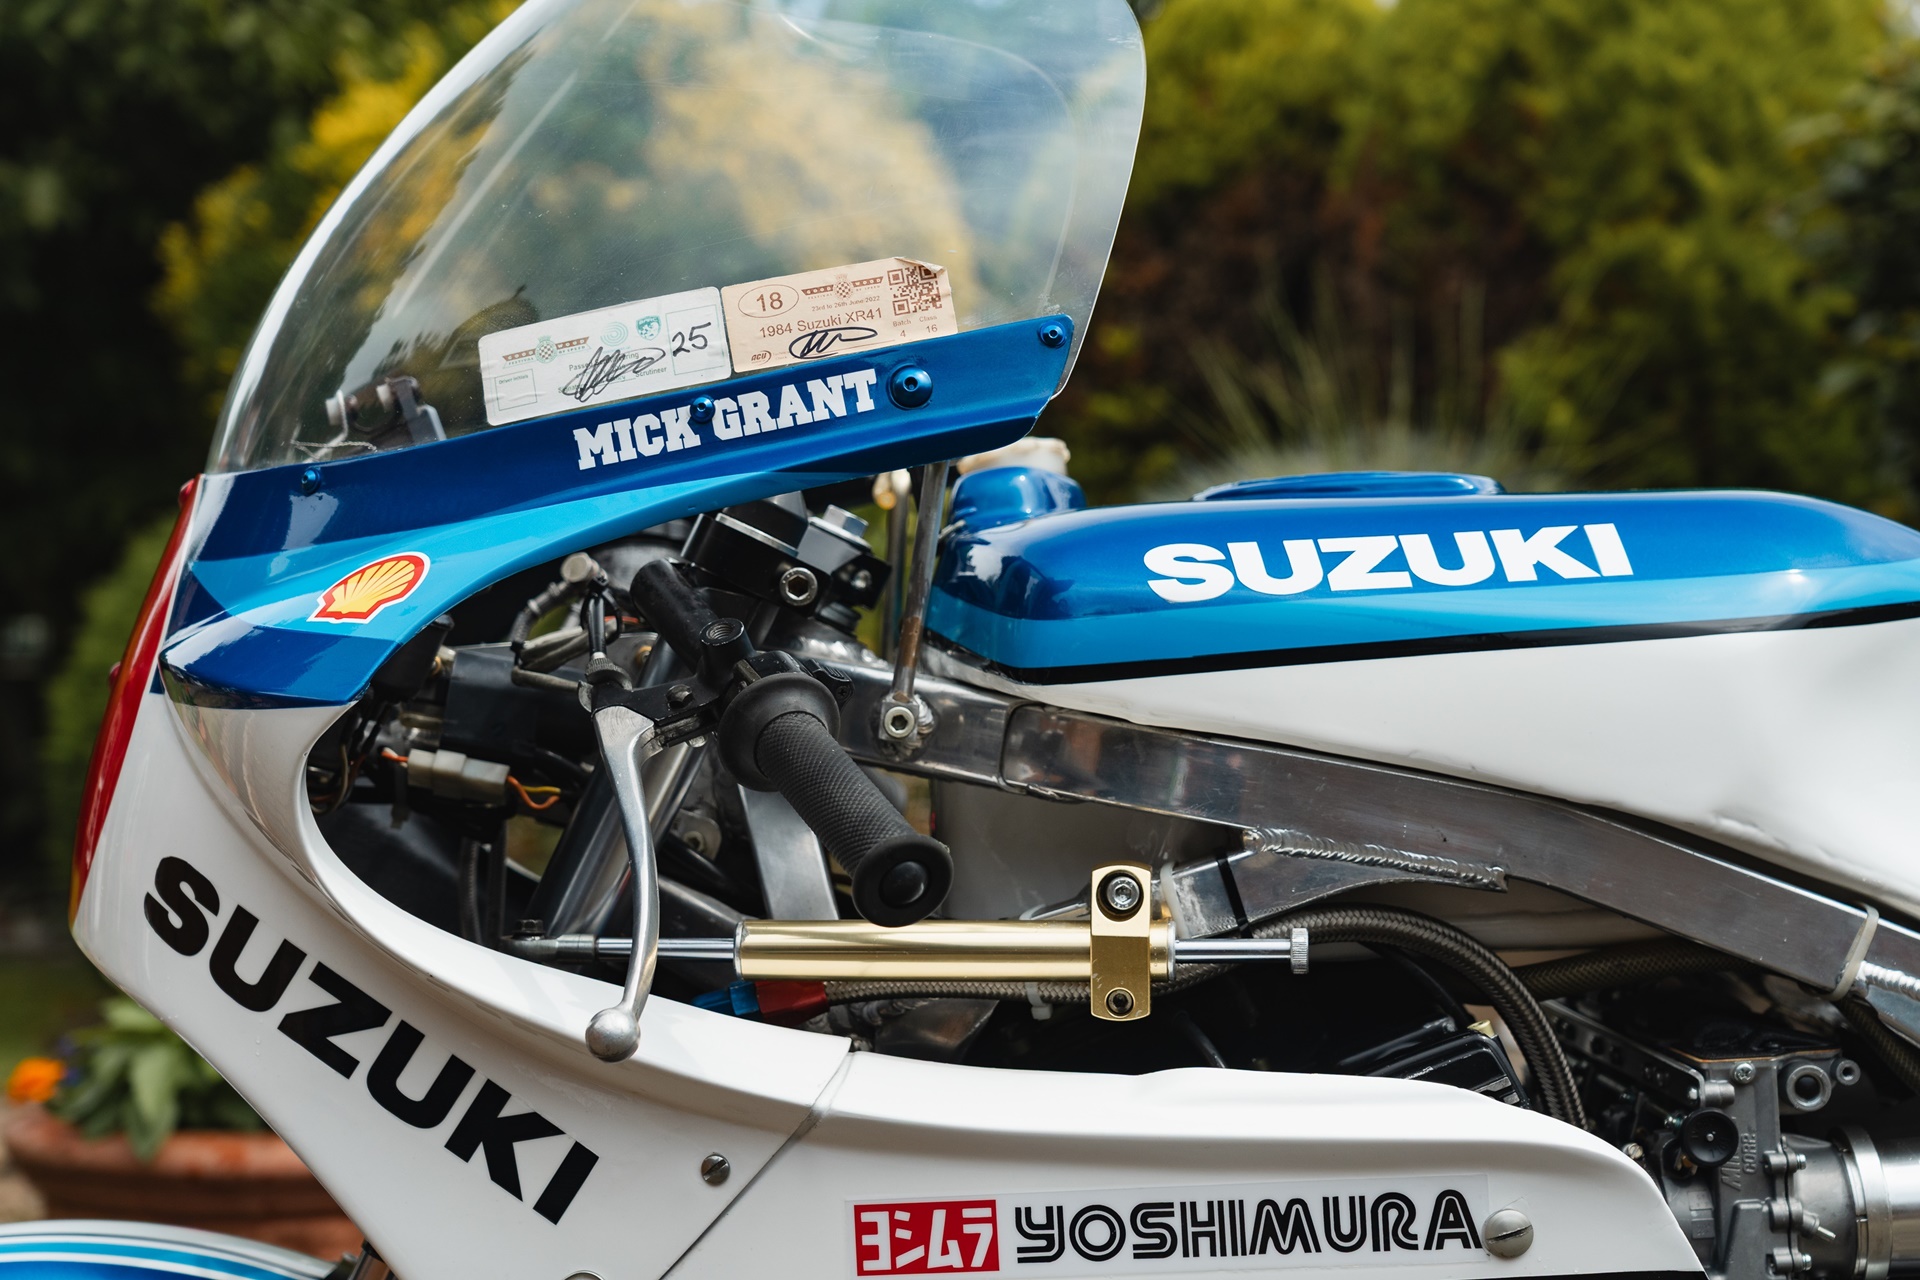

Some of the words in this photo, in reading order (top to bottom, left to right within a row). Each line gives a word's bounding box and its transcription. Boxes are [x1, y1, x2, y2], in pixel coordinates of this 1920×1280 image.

[756, 291, 784, 312] 18
[849, 298, 864, 306] June
[865, 295, 881, 303] 2022
[759, 320, 793, 338] 1984
[797, 313, 842, 332] Suzuki
[846, 307, 883, 324] XR41
[892, 319, 912, 327] Batch
[899, 329, 907, 338] 4
[918, 314, 938, 323] Class
[926, 324, 938, 333] 16
[672, 322, 712, 357] 25
[573, 404, 701, 470] MICK
[712, 368, 877, 441] GRANT
[1143, 522, 1633, 604] SUZUKI
[143, 855, 600, 1226] SUZUKI
[860, 1206, 994, 1271] ヨシムラ
[1014, 1189, 1483, 1264] YOSHIMURA
